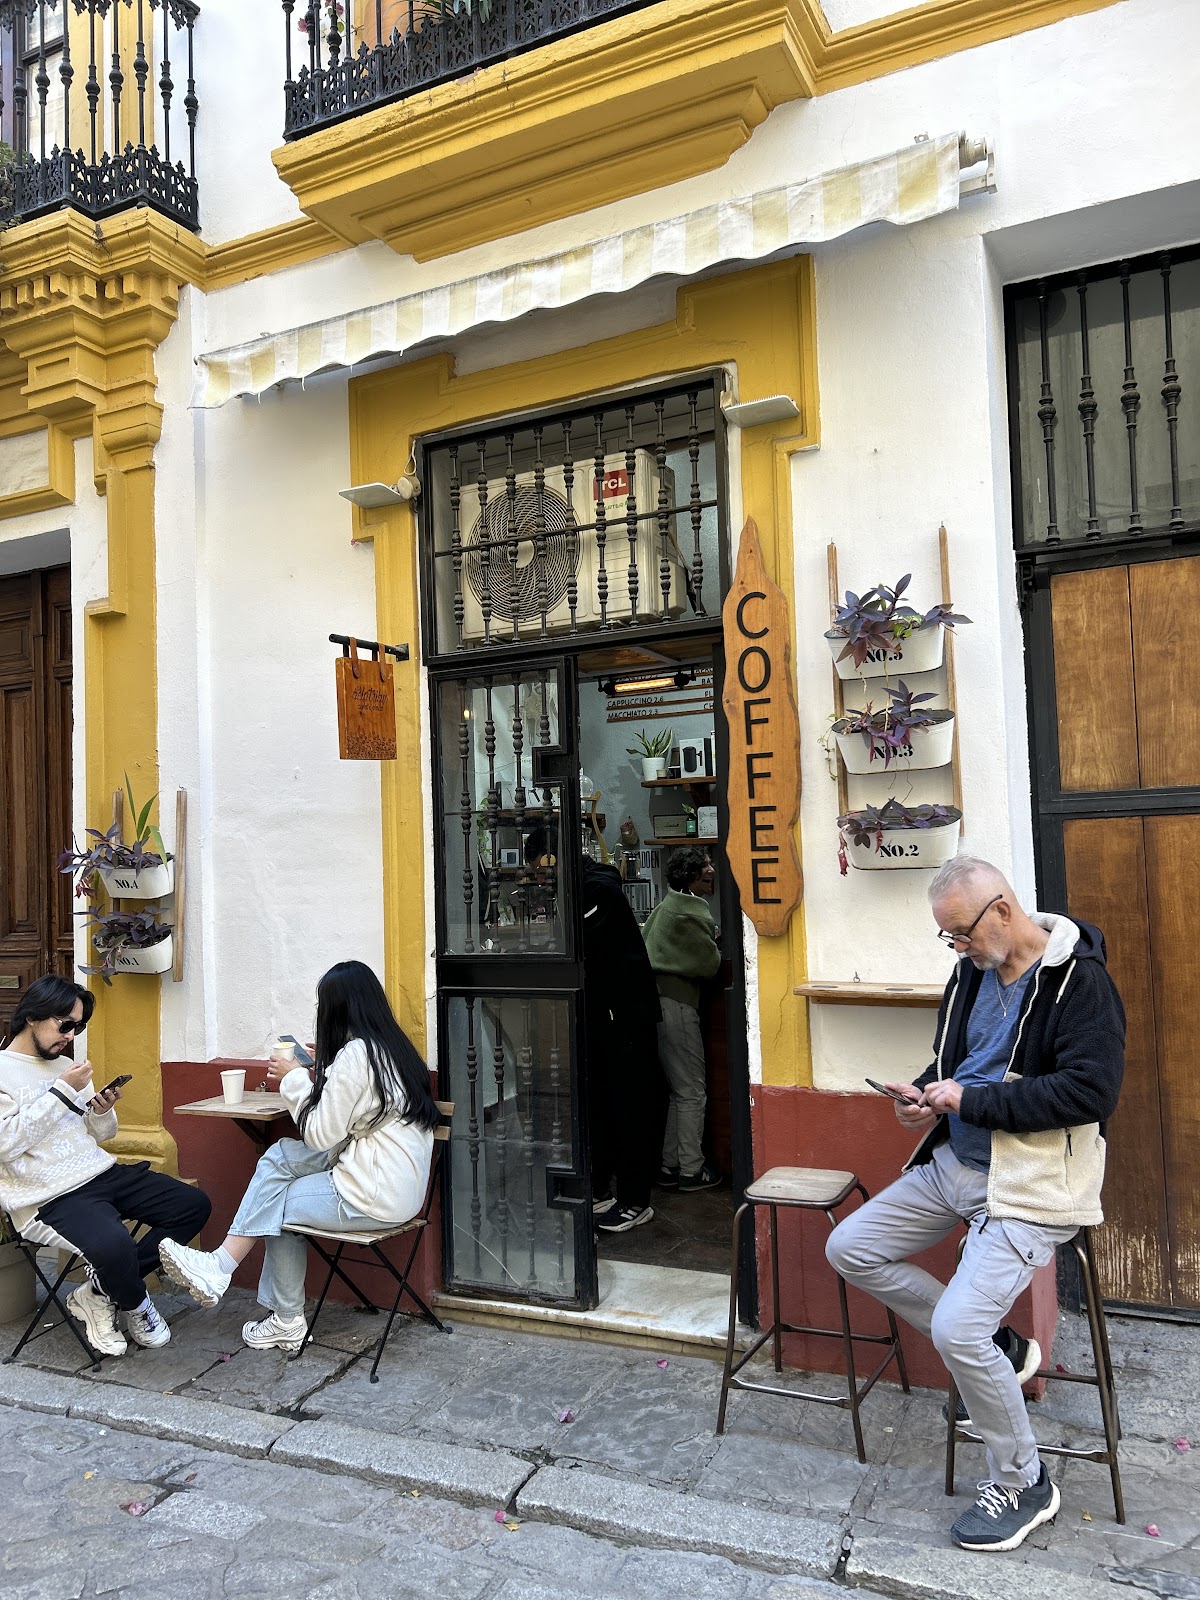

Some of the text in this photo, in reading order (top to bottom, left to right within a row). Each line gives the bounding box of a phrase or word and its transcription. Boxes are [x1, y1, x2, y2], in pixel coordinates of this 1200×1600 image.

[601, 477, 627, 491] TCL
[606, 697, 653, 708] CAPPUCCINO
[607, 709, 647, 719] MACCHIATO
[736, 591, 782, 905] COFFEE
[873, 744, 914, 760] NO.3
[879, 844, 920, 858] NO.2
[113, 878, 140, 890] NO.4
[116, 956, 140, 966] NO.1
